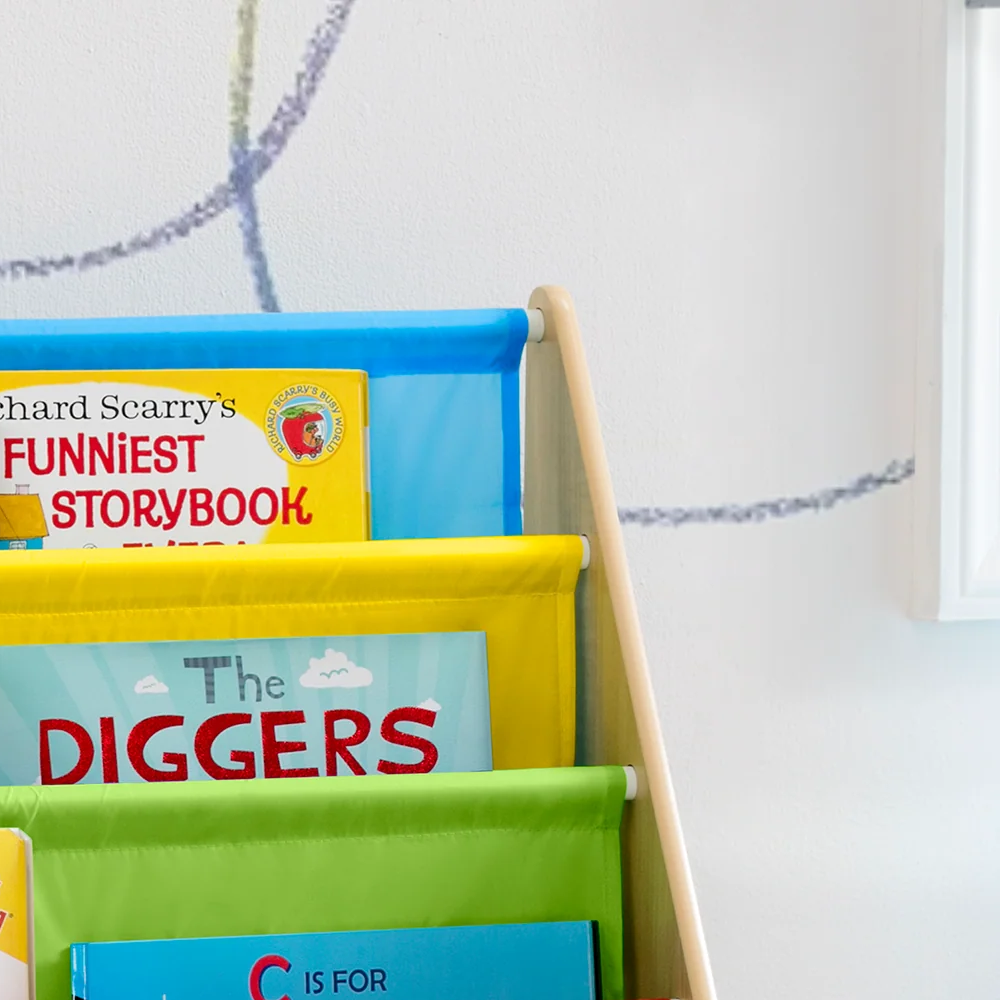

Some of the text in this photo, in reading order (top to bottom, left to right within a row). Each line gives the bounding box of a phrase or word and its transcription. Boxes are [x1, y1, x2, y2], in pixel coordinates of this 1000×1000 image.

[100, 393, 237, 425] Scarry's
[266, 385, 343, 453] RICHARD SCARRY'S BUSY WORLD
[51, 486, 313, 531] STORYBOOK
[183, 655, 285, 704] The
[39, 706, 438, 786] DIGGERS
[304, 970, 325, 994] IS
[333, 968, 388, 993] FOR
